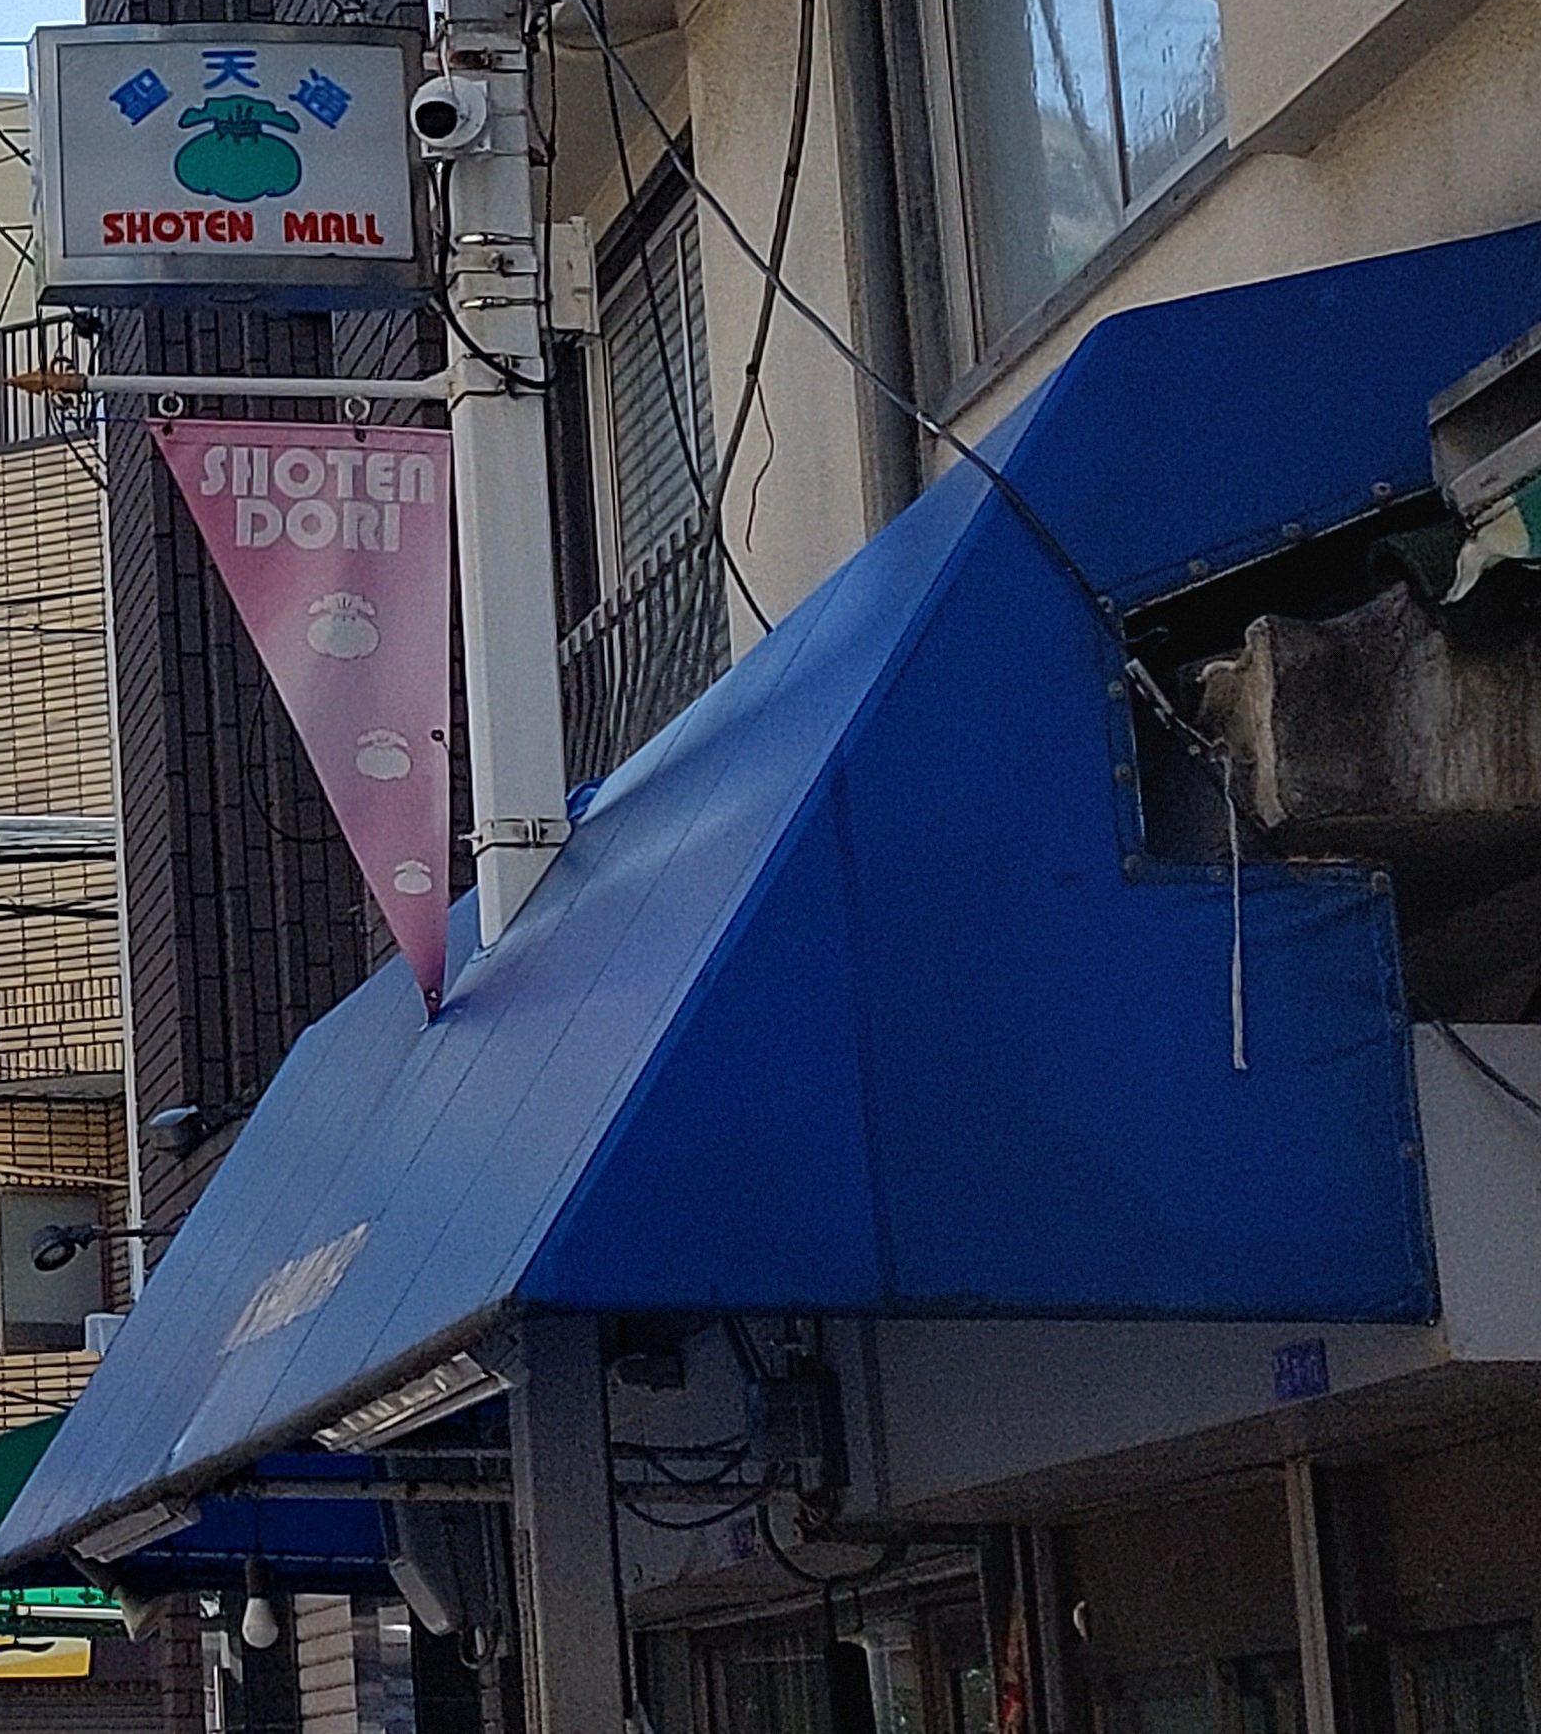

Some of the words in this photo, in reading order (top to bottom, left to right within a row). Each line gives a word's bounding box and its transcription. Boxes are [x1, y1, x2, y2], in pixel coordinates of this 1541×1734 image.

[103, 210, 254, 245] SHOTEN
[283, 211, 384, 245] MALL
[200, 446, 435, 506] SHOTEN
[235, 496, 402, 554] DORI
